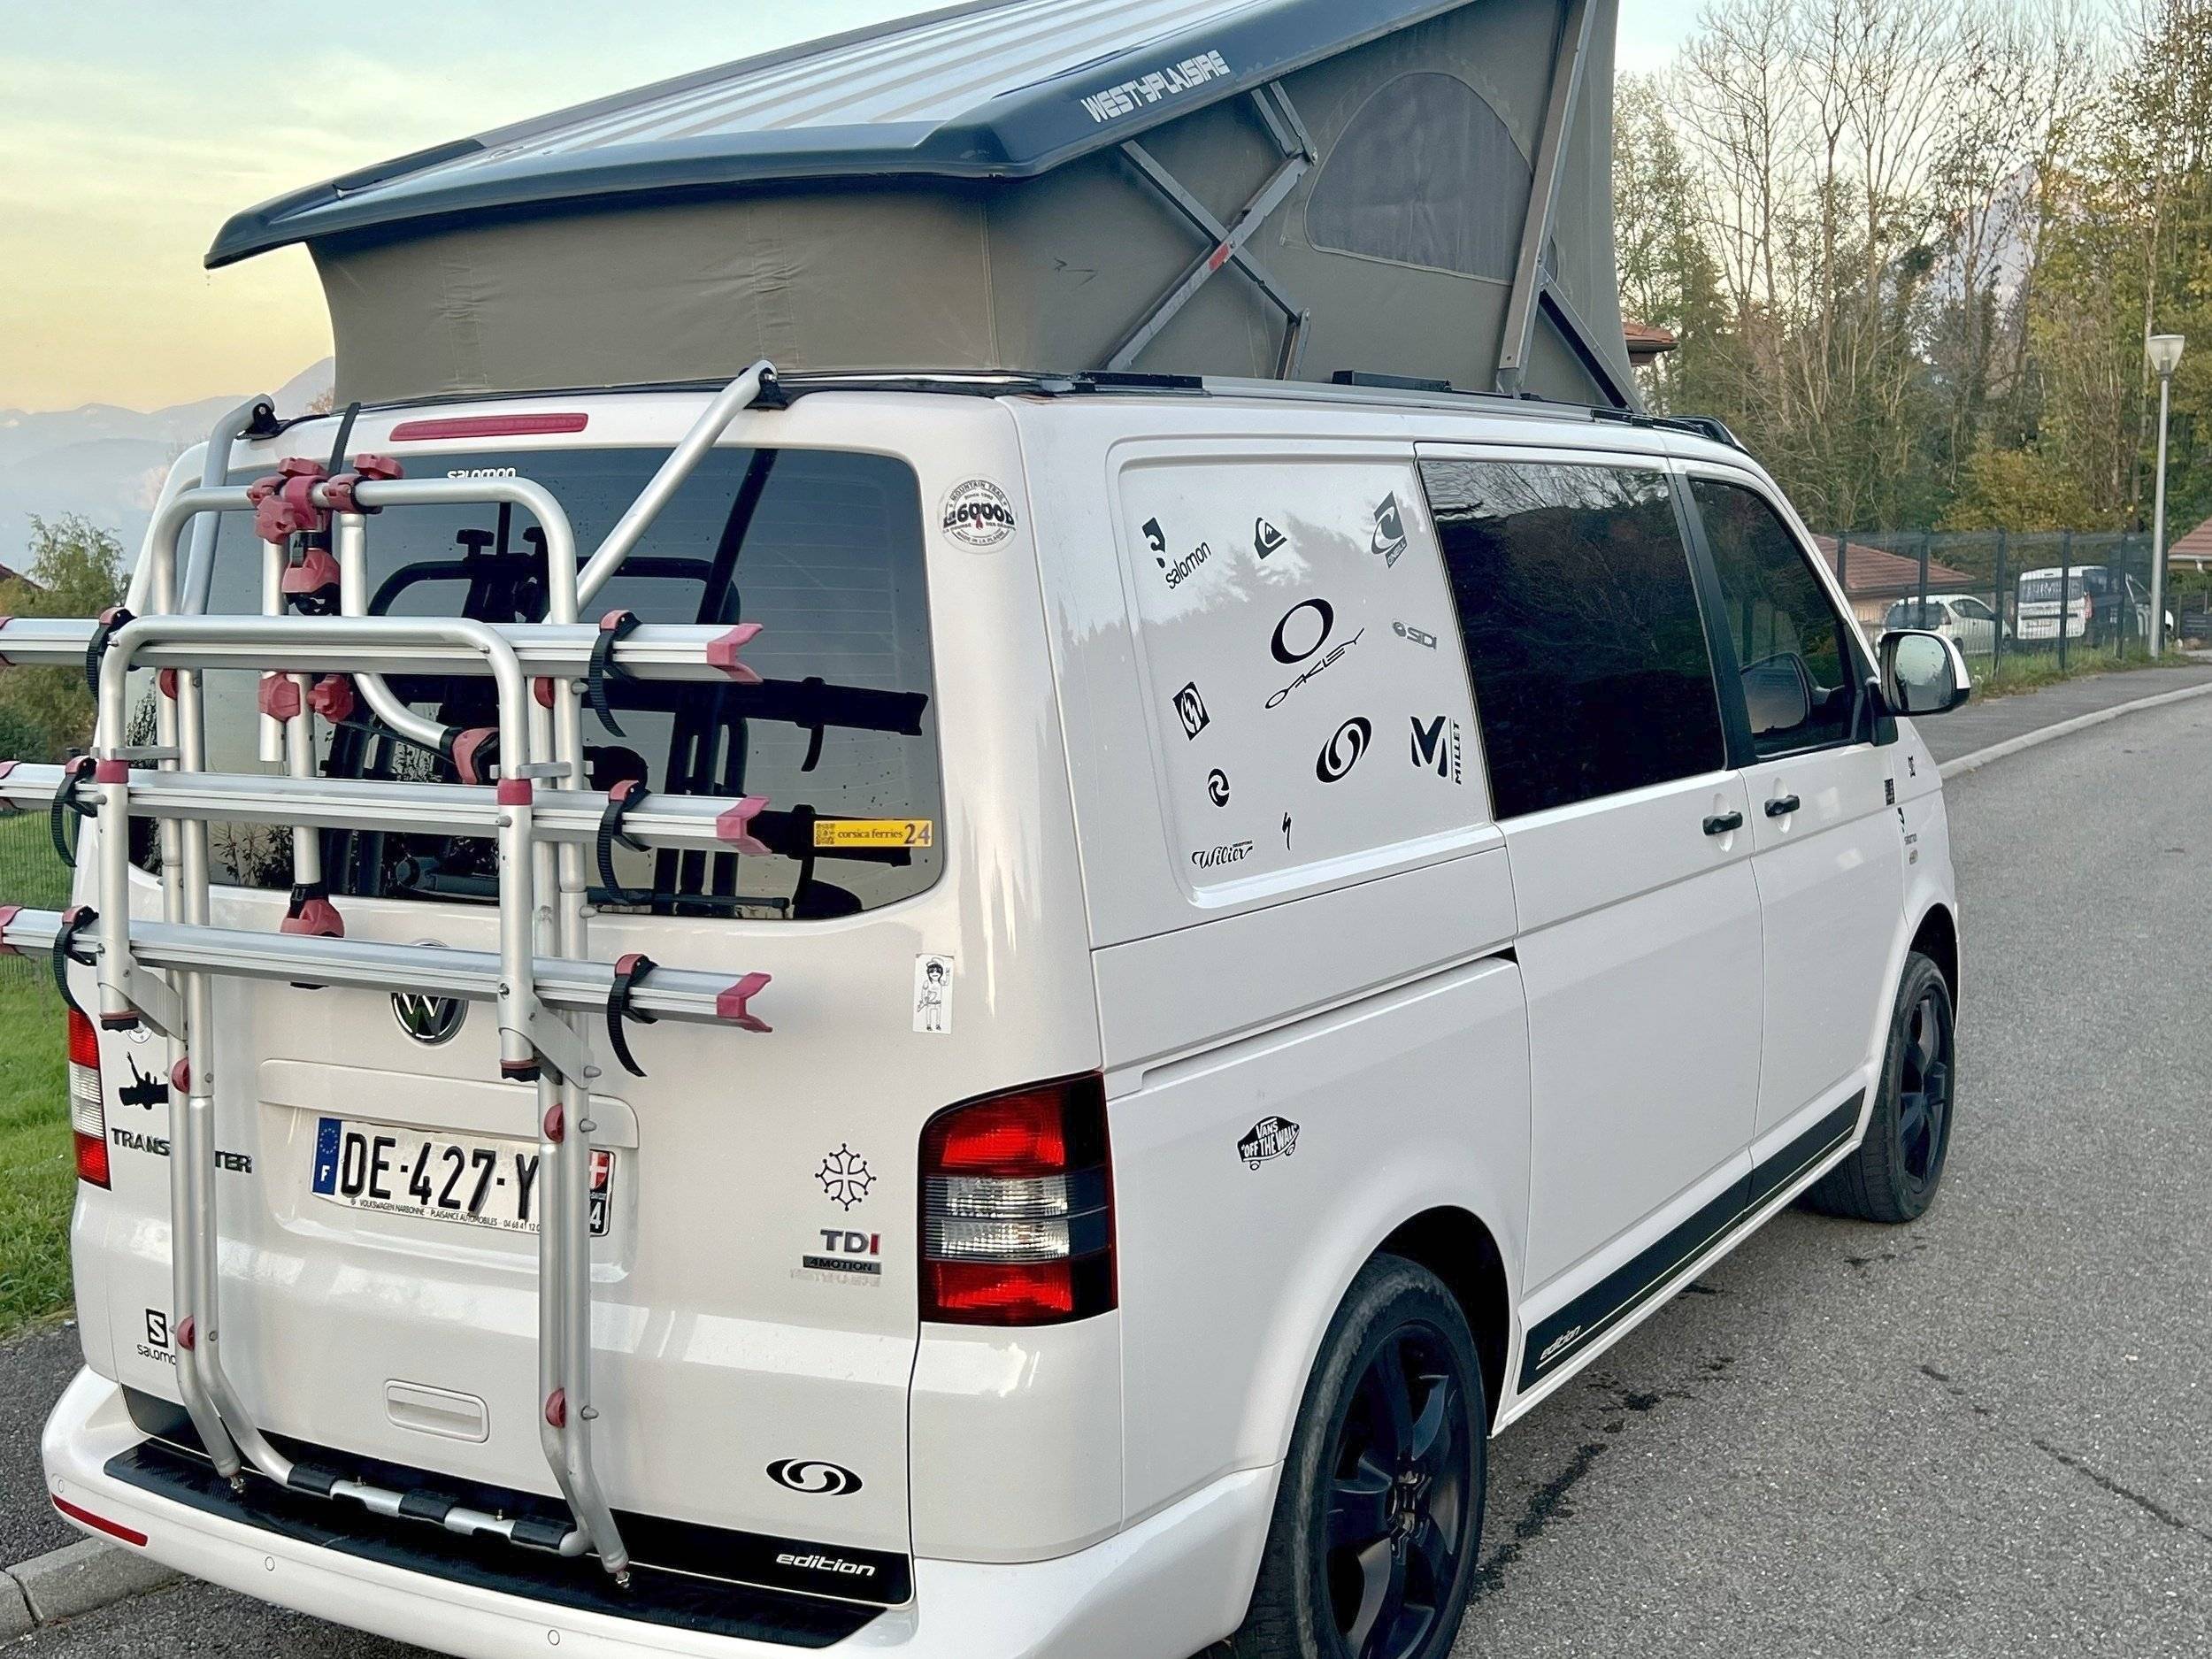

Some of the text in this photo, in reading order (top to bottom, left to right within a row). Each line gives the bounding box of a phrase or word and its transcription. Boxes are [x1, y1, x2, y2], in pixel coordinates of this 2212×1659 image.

[1165, 541, 1211, 590] salomon
[1264, 626, 1364, 709] OAKLEY
[1453, 718, 1462, 785] MILLET
[837, 823, 931, 845] corsica ferries 24
[1191, 845, 1253, 870] Wilier
[1256, 1117, 1279, 1140] VANS
[111, 1128, 252, 1173] TRANSTER
[1259, 1133, 1276, 1156] THE
[320, 1164, 330, 1181] F
[342, 1133, 539, 1221] DE-427-Y
[360, 1199, 394, 1211] VOLKSWAGEN
[395, 1204, 425, 1216] NARBONNE
[430, 1209, 459, 1221] PLAISANCE
[589, 1202, 603, 1229] 4
[820, 1229, 880, 1256] TDI
[810, 1257, 872, 1271] 4MOTION
[137, 1344, 176, 1366] salomo
[776, 1553, 876, 1577] edition
